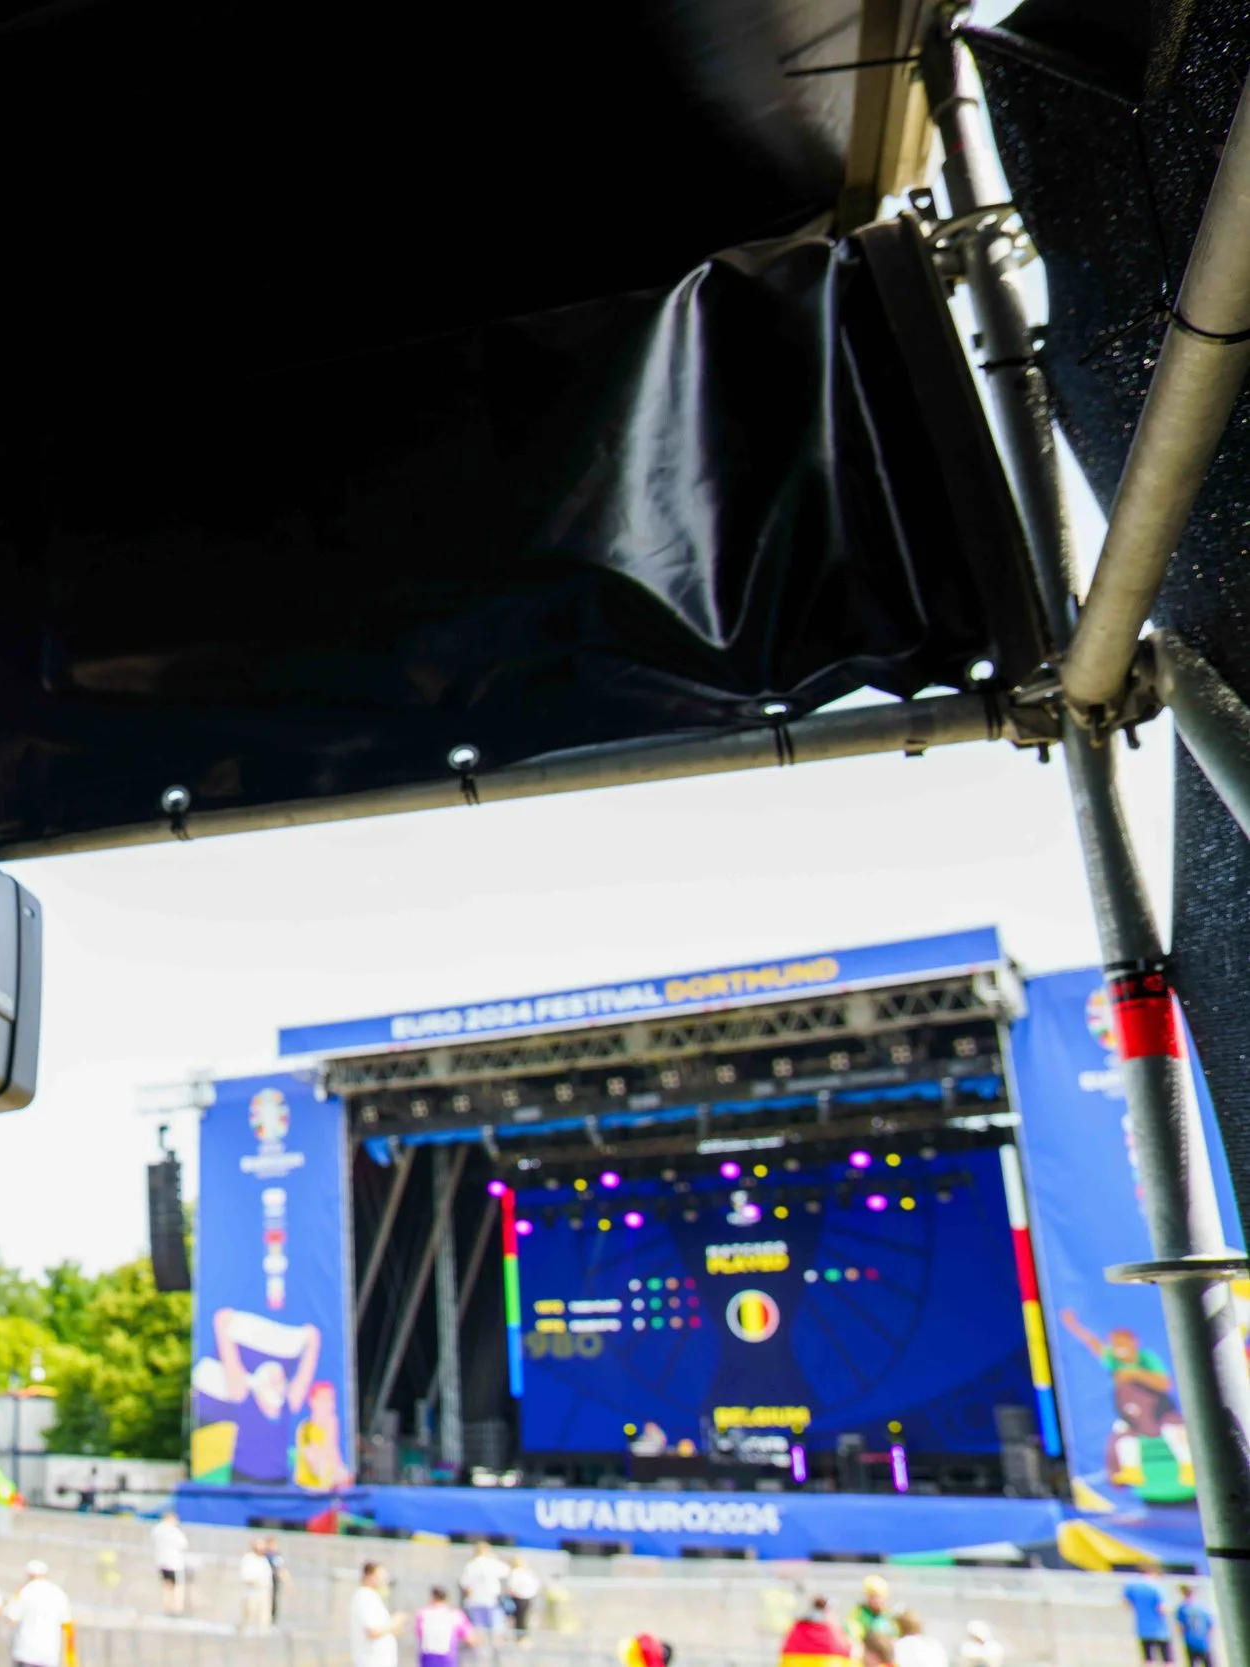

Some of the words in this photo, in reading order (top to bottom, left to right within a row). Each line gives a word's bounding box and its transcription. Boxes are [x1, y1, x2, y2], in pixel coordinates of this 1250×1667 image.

[390, 1006, 461, 1040] EURO
[535, 983, 664, 1021] FESTIVAL
[664, 957, 839, 1003] DORTMUND
